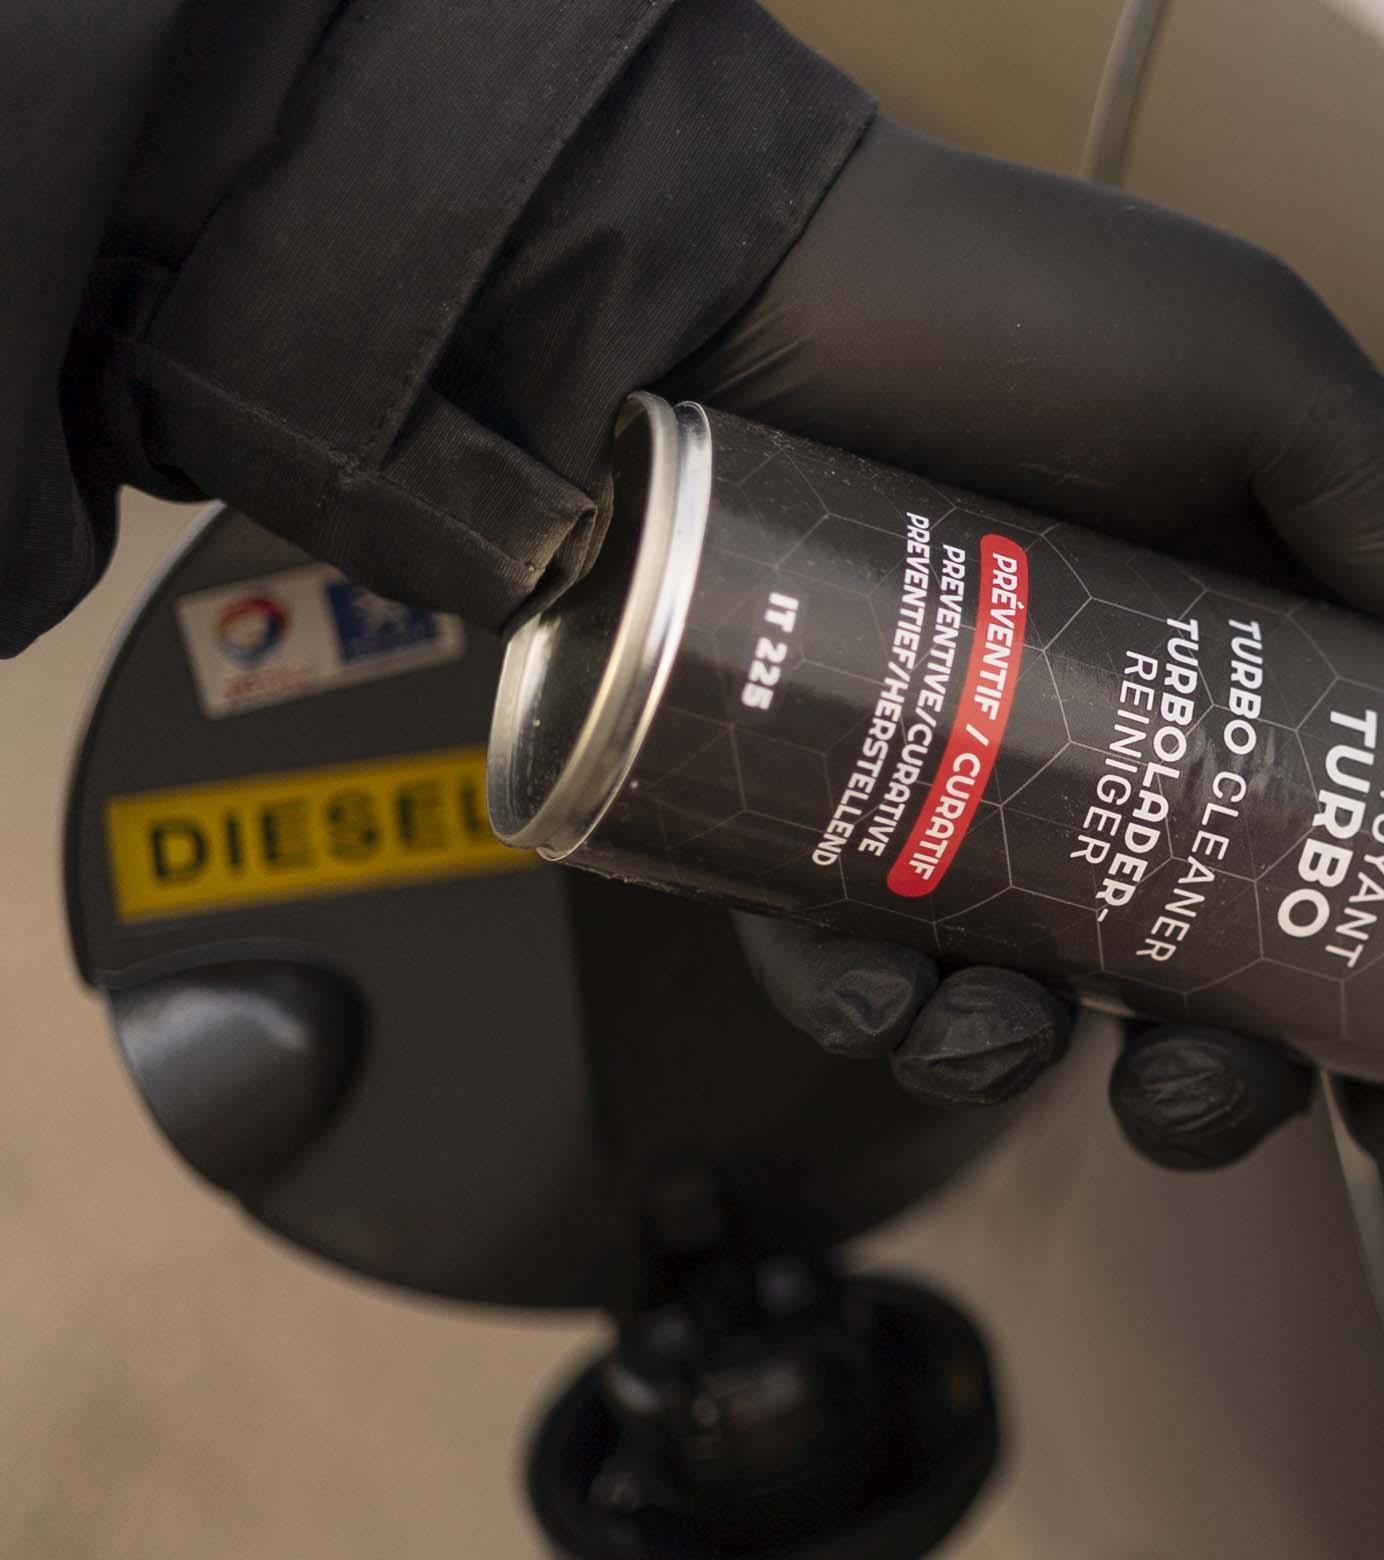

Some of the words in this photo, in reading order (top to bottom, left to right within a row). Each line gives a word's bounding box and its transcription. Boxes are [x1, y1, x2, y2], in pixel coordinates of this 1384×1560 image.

[741, 637, 789, 711] 225
[763, 592, 799, 634] IT
[811, 511, 930, 866] PREVENTIEF/HERSTELLEND
[858, 543, 966, 857] PREVENTIVE/CURATIVE
[973, 552, 1024, 720] PRÉVENTIF
[1223, 618, 1263, 755] TURBO
[908, 752, 981, 880] CURATIF
[965, 724, 989, 746] /
[1070, 650, 1159, 864] REINIGER
[1096, 618, 1199, 922] TURBOLADER-
[1277, 710, 1378, 938] TURBO
[1135, 771, 1248, 962] CLEANER
